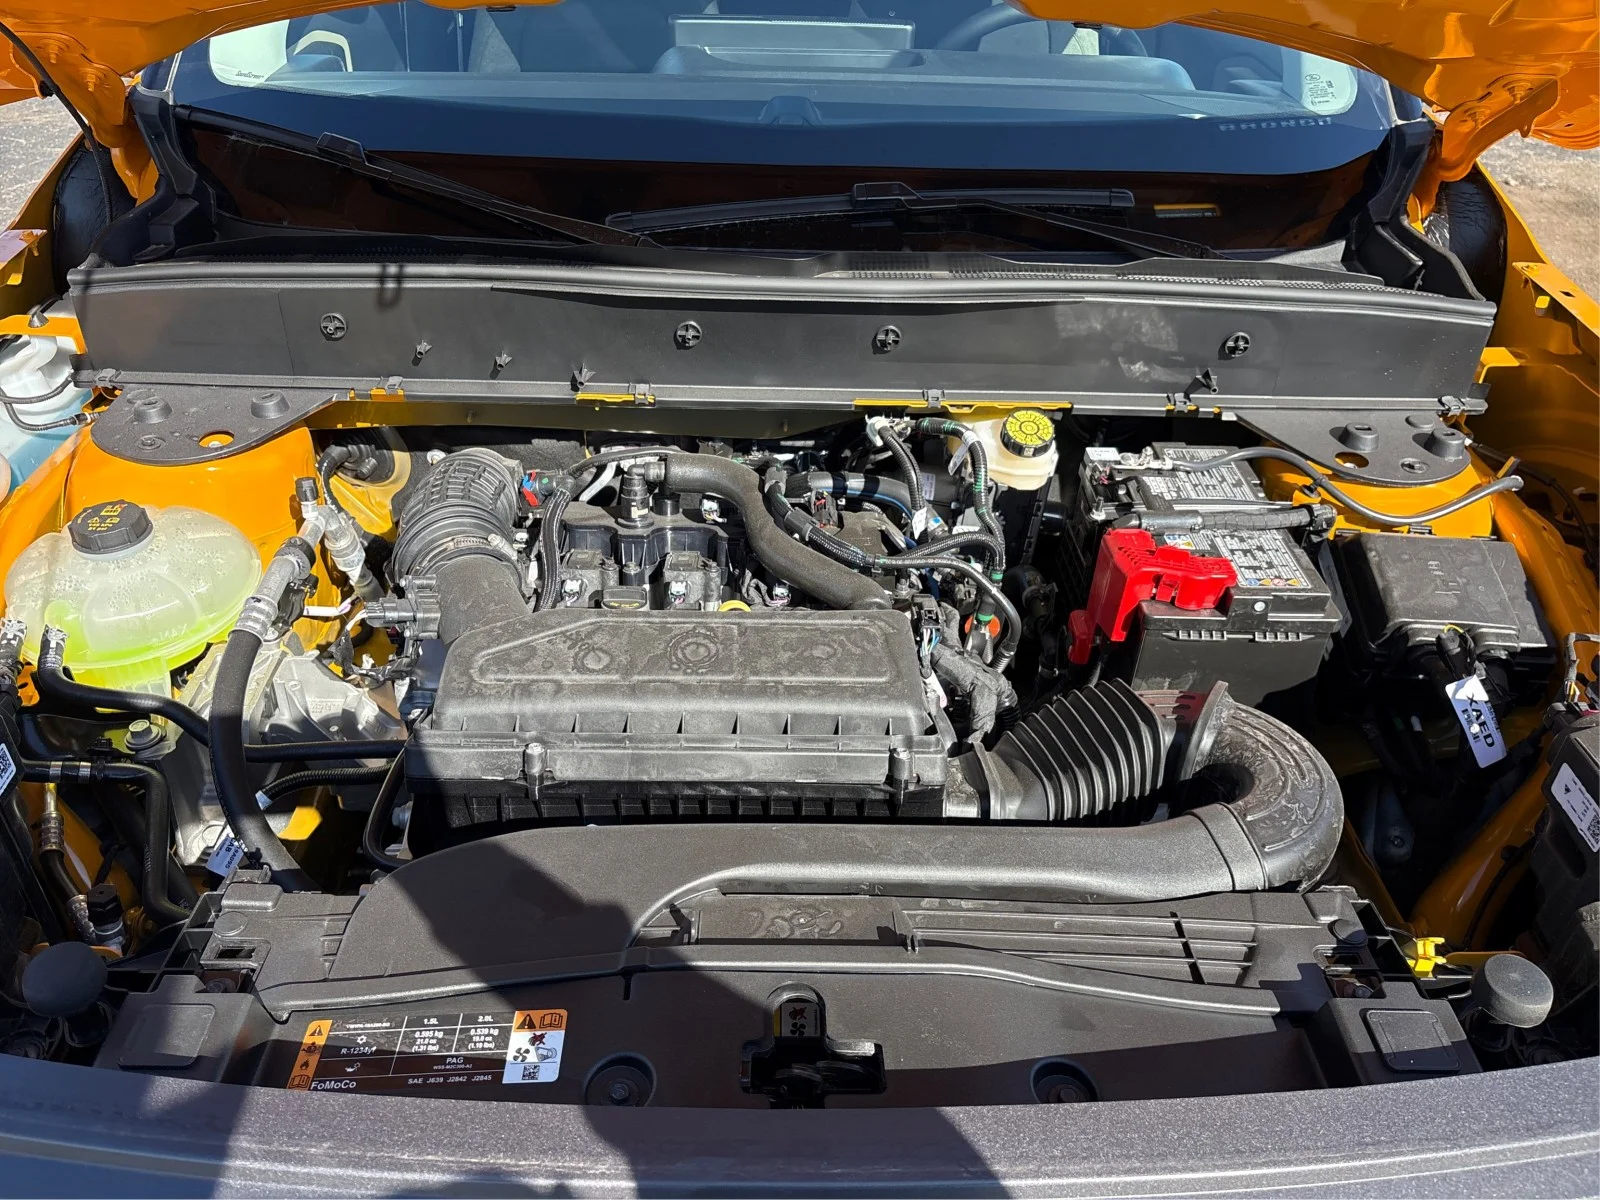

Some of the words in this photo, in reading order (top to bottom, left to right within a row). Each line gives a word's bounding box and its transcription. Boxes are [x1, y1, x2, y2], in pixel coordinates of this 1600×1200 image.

[1466, 693, 1495, 747] XAED
[423, 1017, 439, 1025] 1.5L
[434, 1030, 444, 1038] kg
[470, 1028, 489, 1036] 0.539
[489, 1027, 499, 1036] kg
[340, 1046, 377, 1055] R-1234yf
[446, 1056, 464, 1064] PAG
[310, 1080, 357, 1090] FoMoCo
